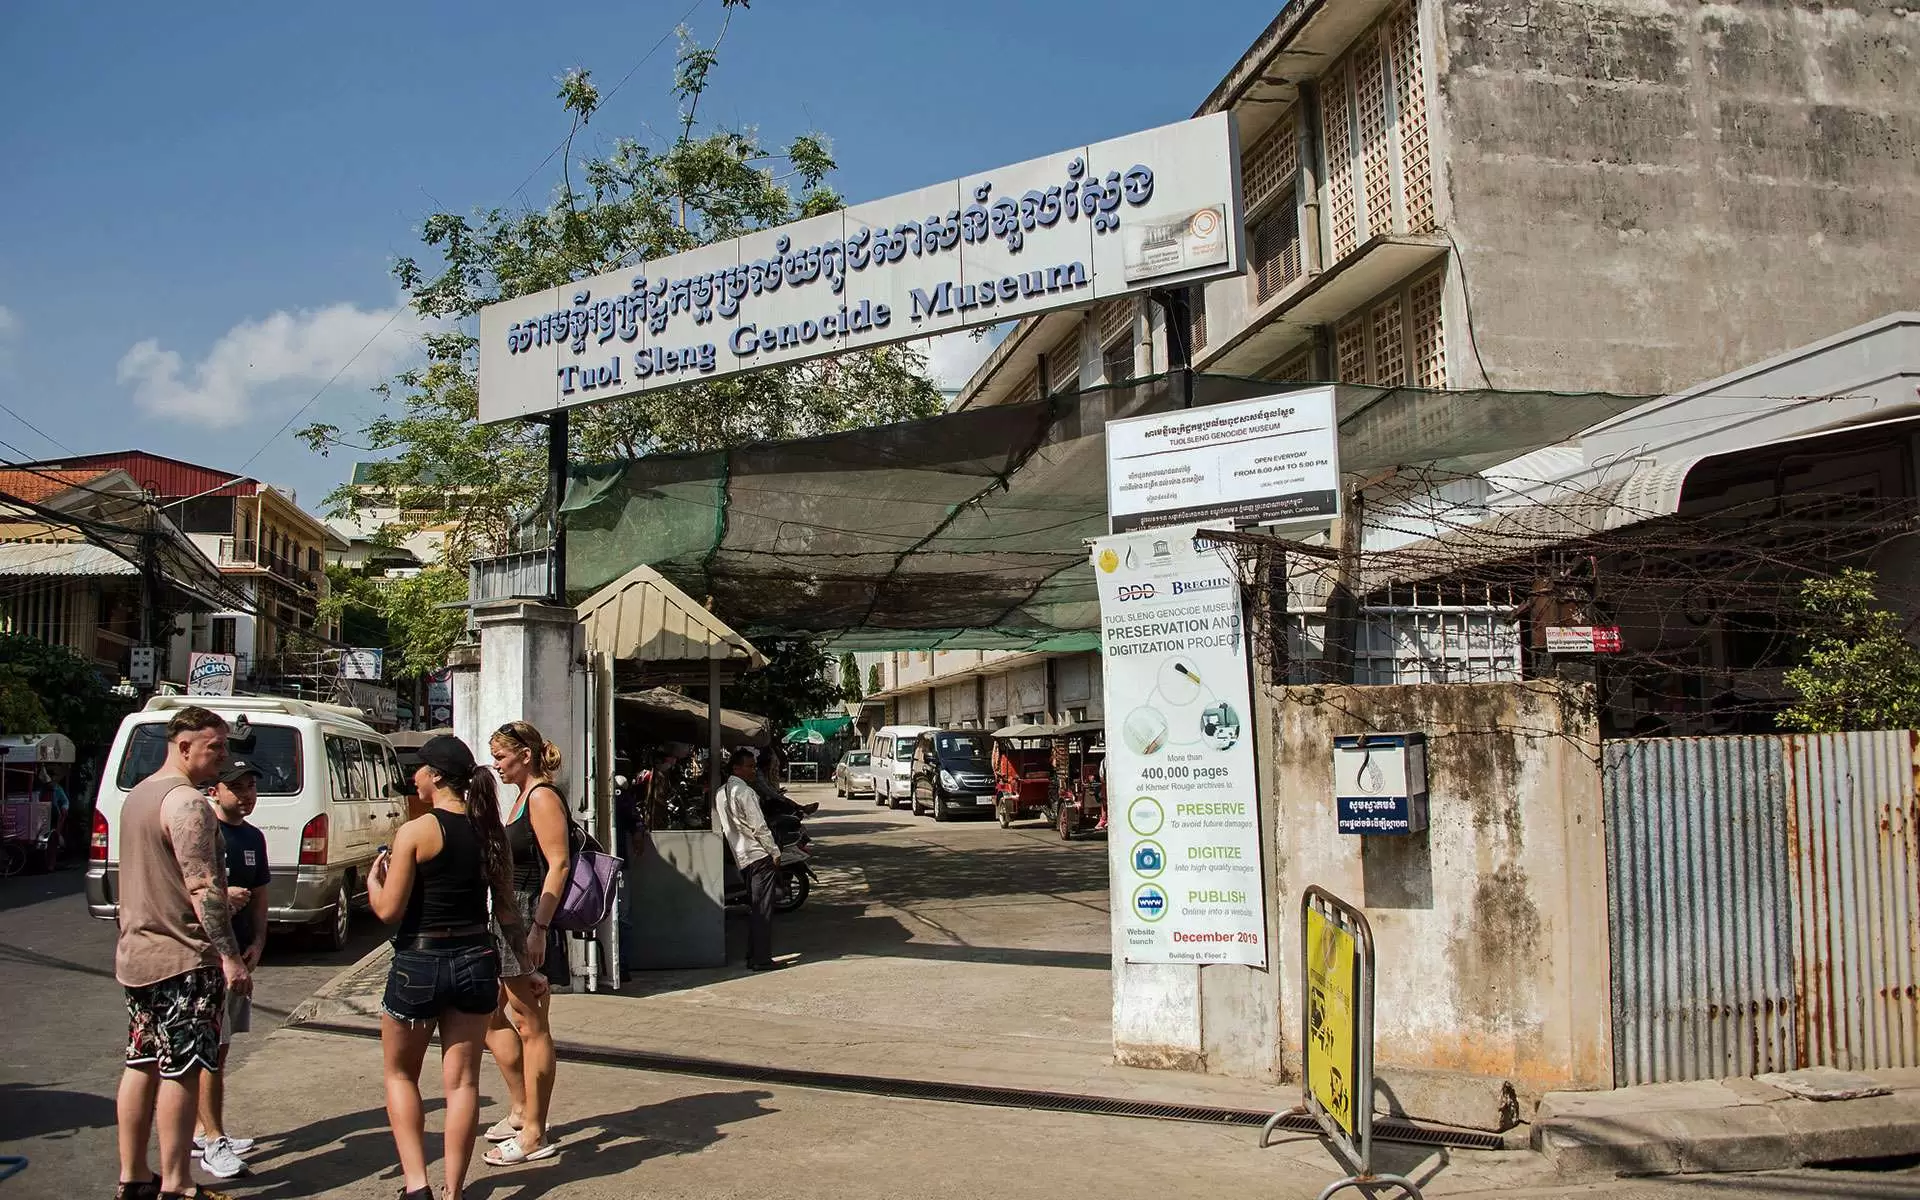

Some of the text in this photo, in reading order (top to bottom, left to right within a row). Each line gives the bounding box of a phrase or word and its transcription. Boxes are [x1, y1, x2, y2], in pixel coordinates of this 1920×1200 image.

[558, 261, 1087, 395] Tuol Sleng Genocide Museum
[1211, 428, 1248, 440] GENOCIDE
[1248, 423, 1281, 433] MUSEUM
[1254, 451, 1307, 464] OPEN EVERYDAY
[1233, 468, 1256, 477] FROM
[1273, 464, 1286, 472] AM
[1118, 583, 1155, 602] DDD
[1105, 614, 1126, 624] TUOL
[1127, 611, 1155, 622] SLENG
[1156, 605, 1201, 620] GENOCIDE
[1202, 602, 1240, 614] MUSEUM
[1108, 615, 1240, 641] PRESERVATION AND
[1109, 632, 1241, 657] DIGITIZATION PROJECT
[1167, 753, 1203, 762] More than
[1141, 765, 1229, 780] 400,000 pages
[1136, 783, 1144, 791] of
[1145, 783, 1169, 791] Khmer
[1171, 782, 1195, 792] Rouge
[1196, 781, 1225, 790] archives
[1176, 802, 1246, 816] PRESERVE
[1171, 820, 1253, 829] To avoid future damages
[1188, 846, 1242, 860] DIGITIZE
[1190, 863, 1207, 873] high
[1208, 863, 1232, 873] quality
[1232, 864, 1255, 873] images
[1188, 890, 1247, 904] PUBLISH
[1181, 907, 1207, 916] Online
[1208, 907, 1223, 916] into
[1126, 928, 1156, 936] Website
[1173, 931, 1258, 944] December 2019
[1168, 952, 1195, 961] Building
[1204, 952, 1221, 960] Floor
